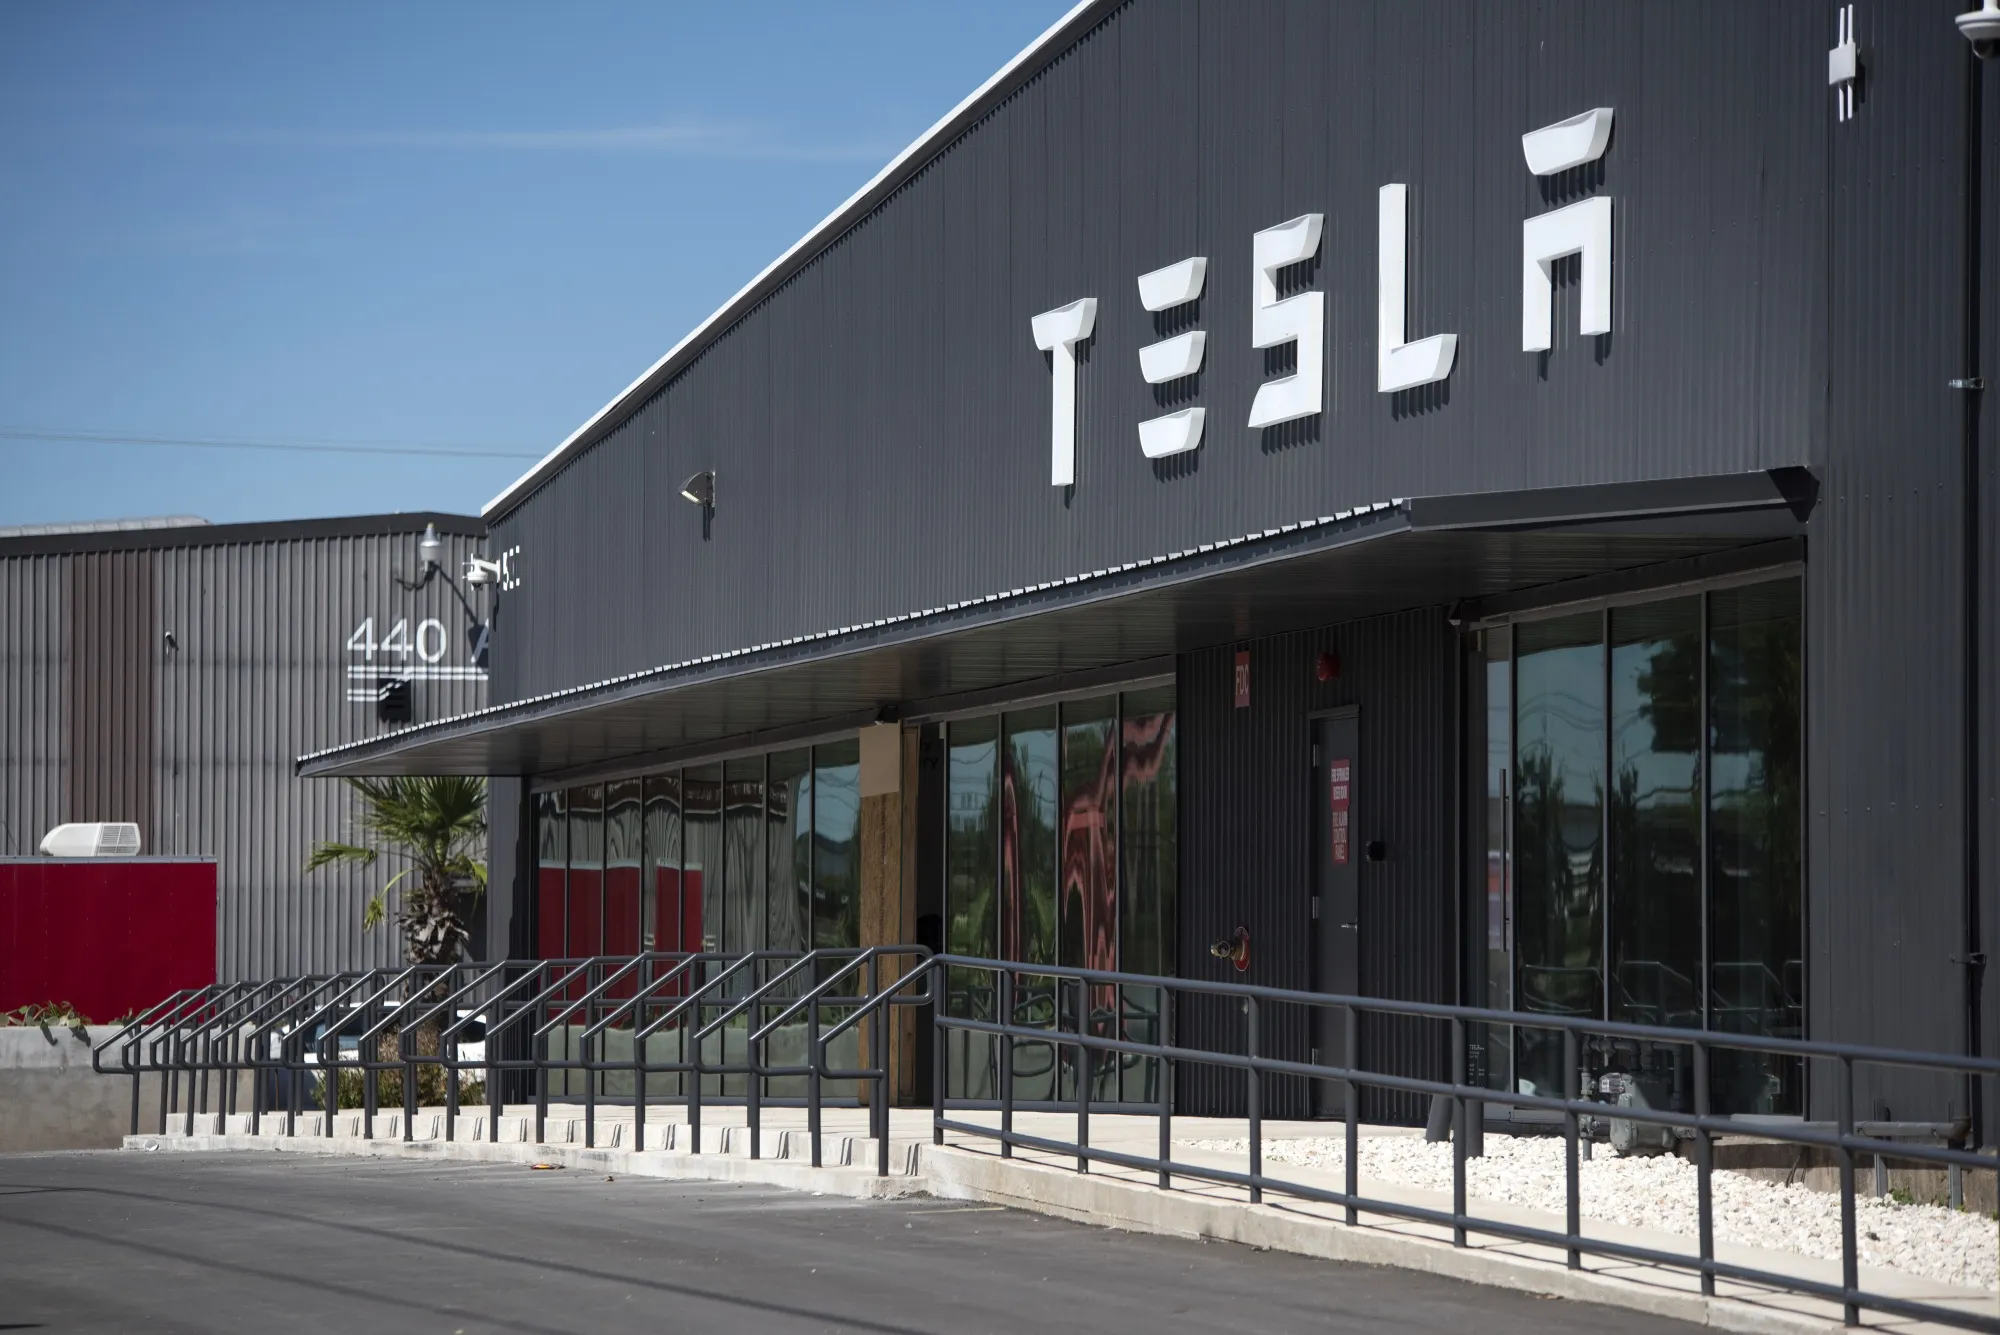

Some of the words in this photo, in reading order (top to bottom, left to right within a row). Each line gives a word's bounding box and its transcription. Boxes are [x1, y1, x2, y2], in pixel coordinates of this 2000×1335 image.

[1031, 107, 1613, 486] TESLA
[347, 616, 447, 664] 440
[1236, 663, 1249, 695] FDC
